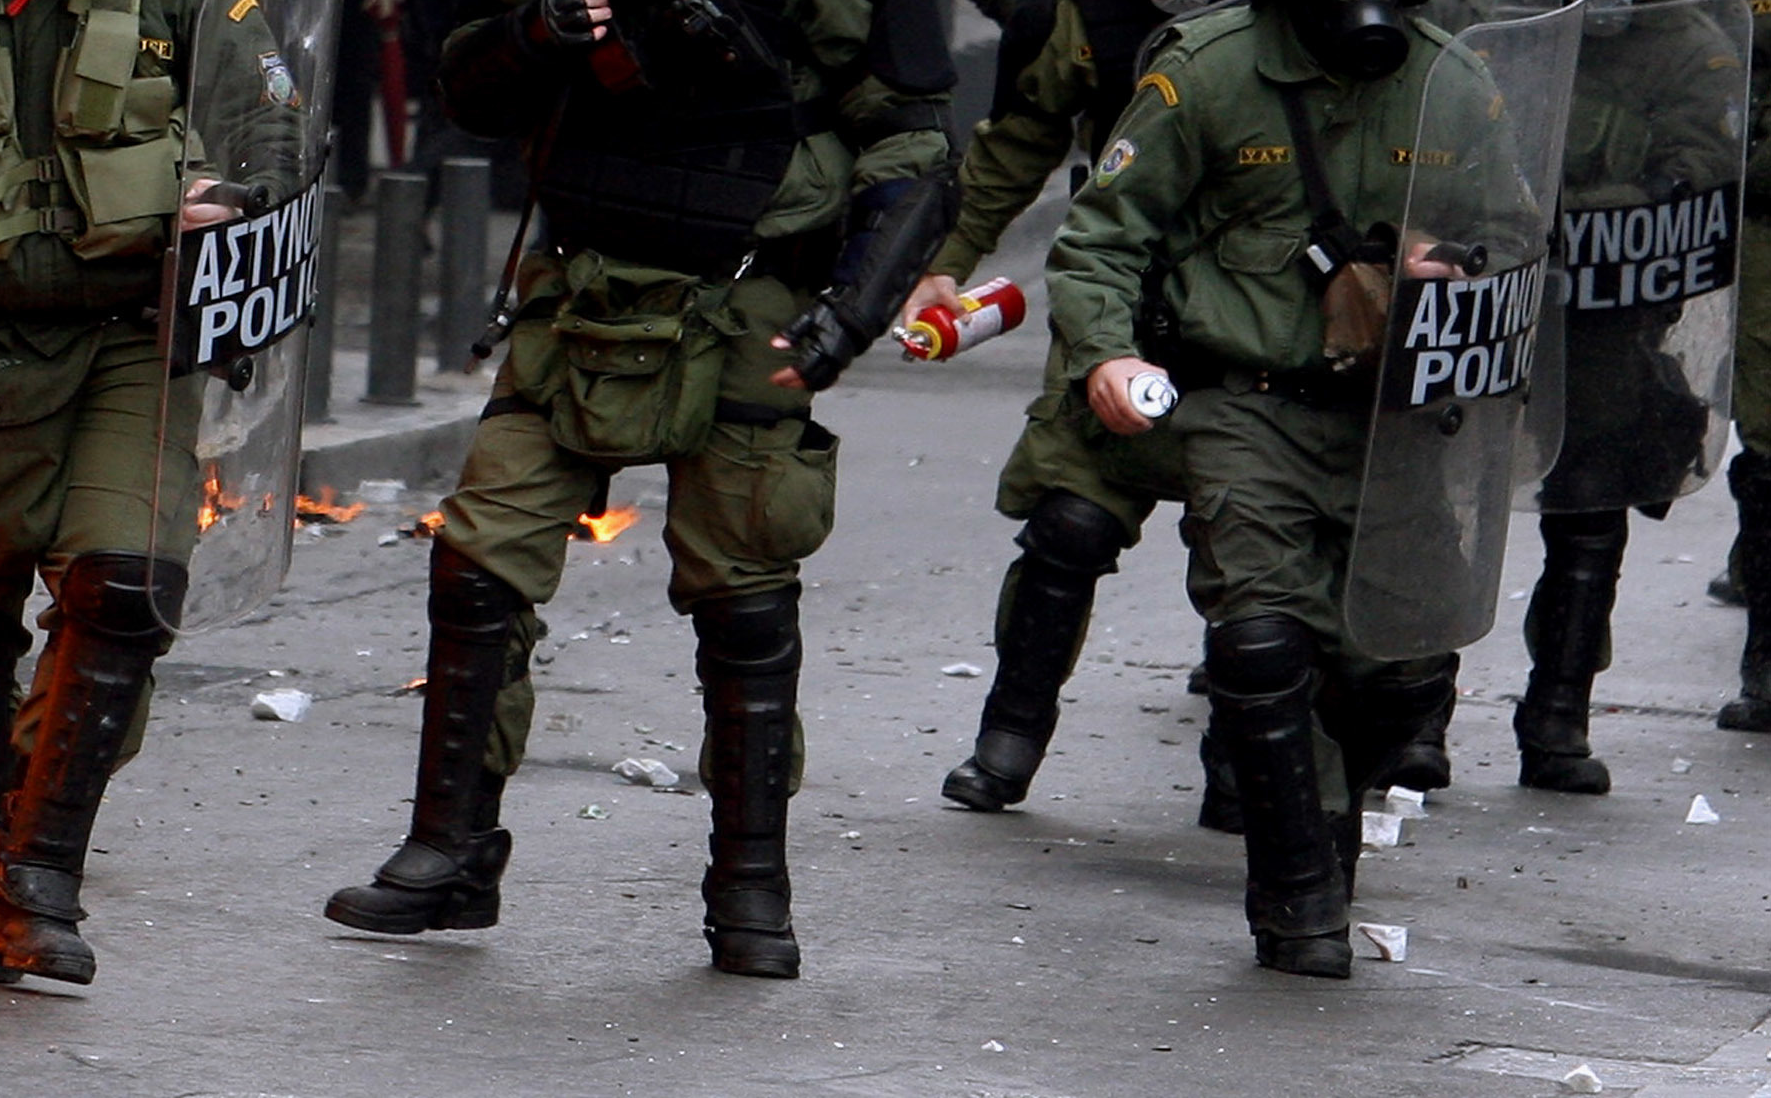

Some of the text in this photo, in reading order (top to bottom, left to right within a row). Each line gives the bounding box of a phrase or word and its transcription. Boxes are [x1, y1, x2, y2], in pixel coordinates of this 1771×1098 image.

[188, 175, 322, 306] ΑΣΤΥΝΟ
[1563, 189, 1728, 266] ΥΝΟΜΙΑ
[197, 252, 318, 364] POLIC
[1404, 253, 1549, 349] ΑΣΤΥΝΟ
[1410, 325, 1536, 405] POLIC
